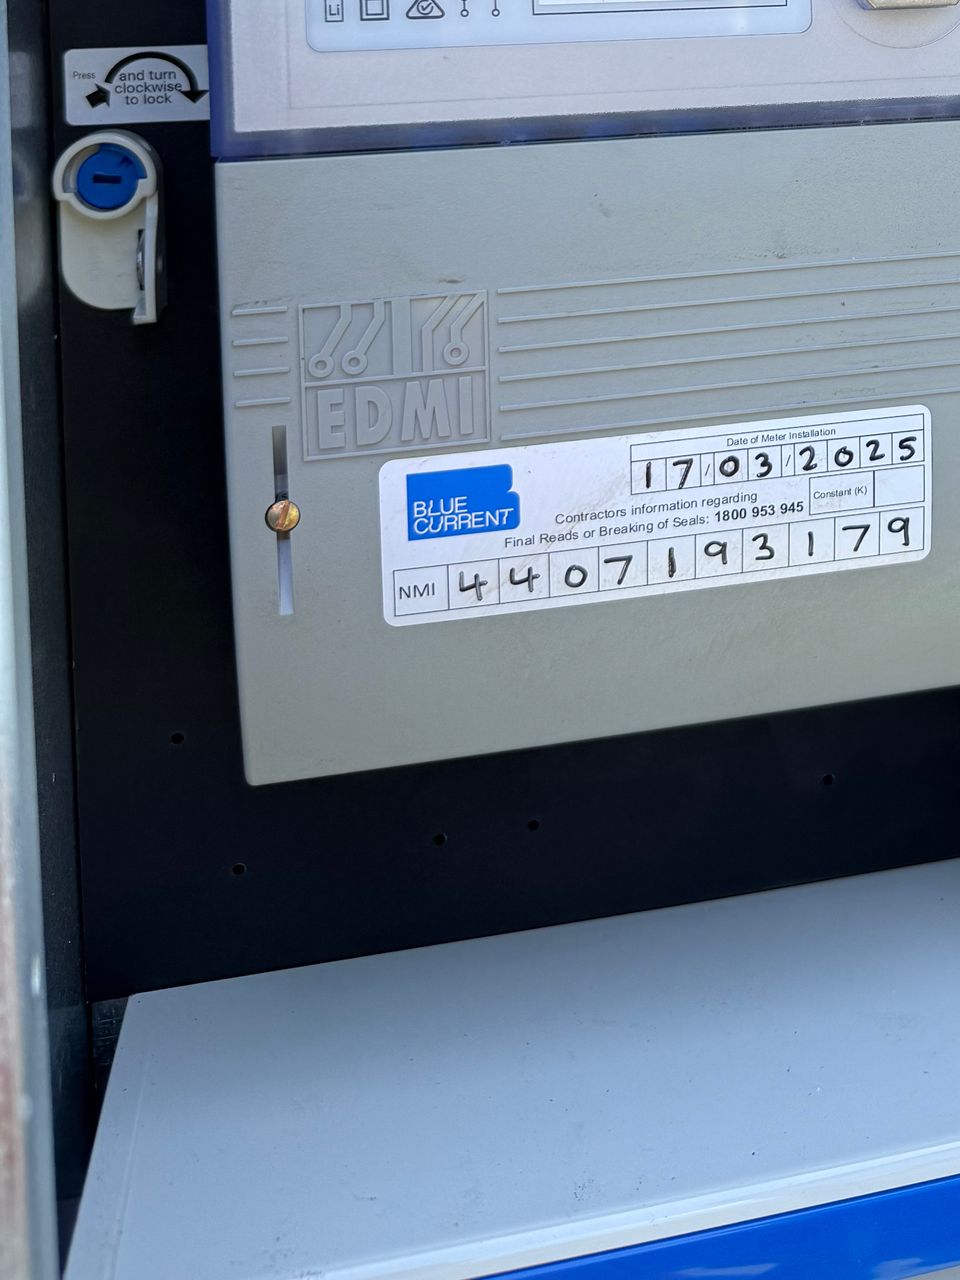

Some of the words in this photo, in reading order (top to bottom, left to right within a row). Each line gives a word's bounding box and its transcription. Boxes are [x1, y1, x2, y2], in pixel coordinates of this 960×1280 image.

[72, 70, 96, 80] Press
[119, 70, 144, 81] and
[149, 70, 177, 80] turn
[114, 80, 182, 94] clockwise
[125, 95, 139, 105] to
[143, 93, 173, 105] lock
[316, 376, 474, 451] EDMI
[726, 435, 750, 448] Date
[750, 434, 760, 445] of
[760, 432, 788, 444] Meter
[788, 427, 836, 442] Installation
[813, 487, 852, 501] Constant
[854, 485, 868, 498] (K)
[413, 495, 468, 518] BLUE
[555, 507, 627, 525] Contractors
[631, 498, 698, 516] information
[701, 491, 758, 509] regarding
[413, 507, 515, 535] CURRENT
[505, 533, 536, 549] Final
[540, 530, 579, 544] Reads
[583, 529, 595, 539] or
[599, 521, 654, 537] Breaking
[657, 518, 668, 530] of
[672, 514, 710, 528] Seals:
[715, 507, 747, 522] 1800
[752, 504, 776, 518] 953
[780, 501, 804, 515] 945
[399, 581, 436, 600] NMI
